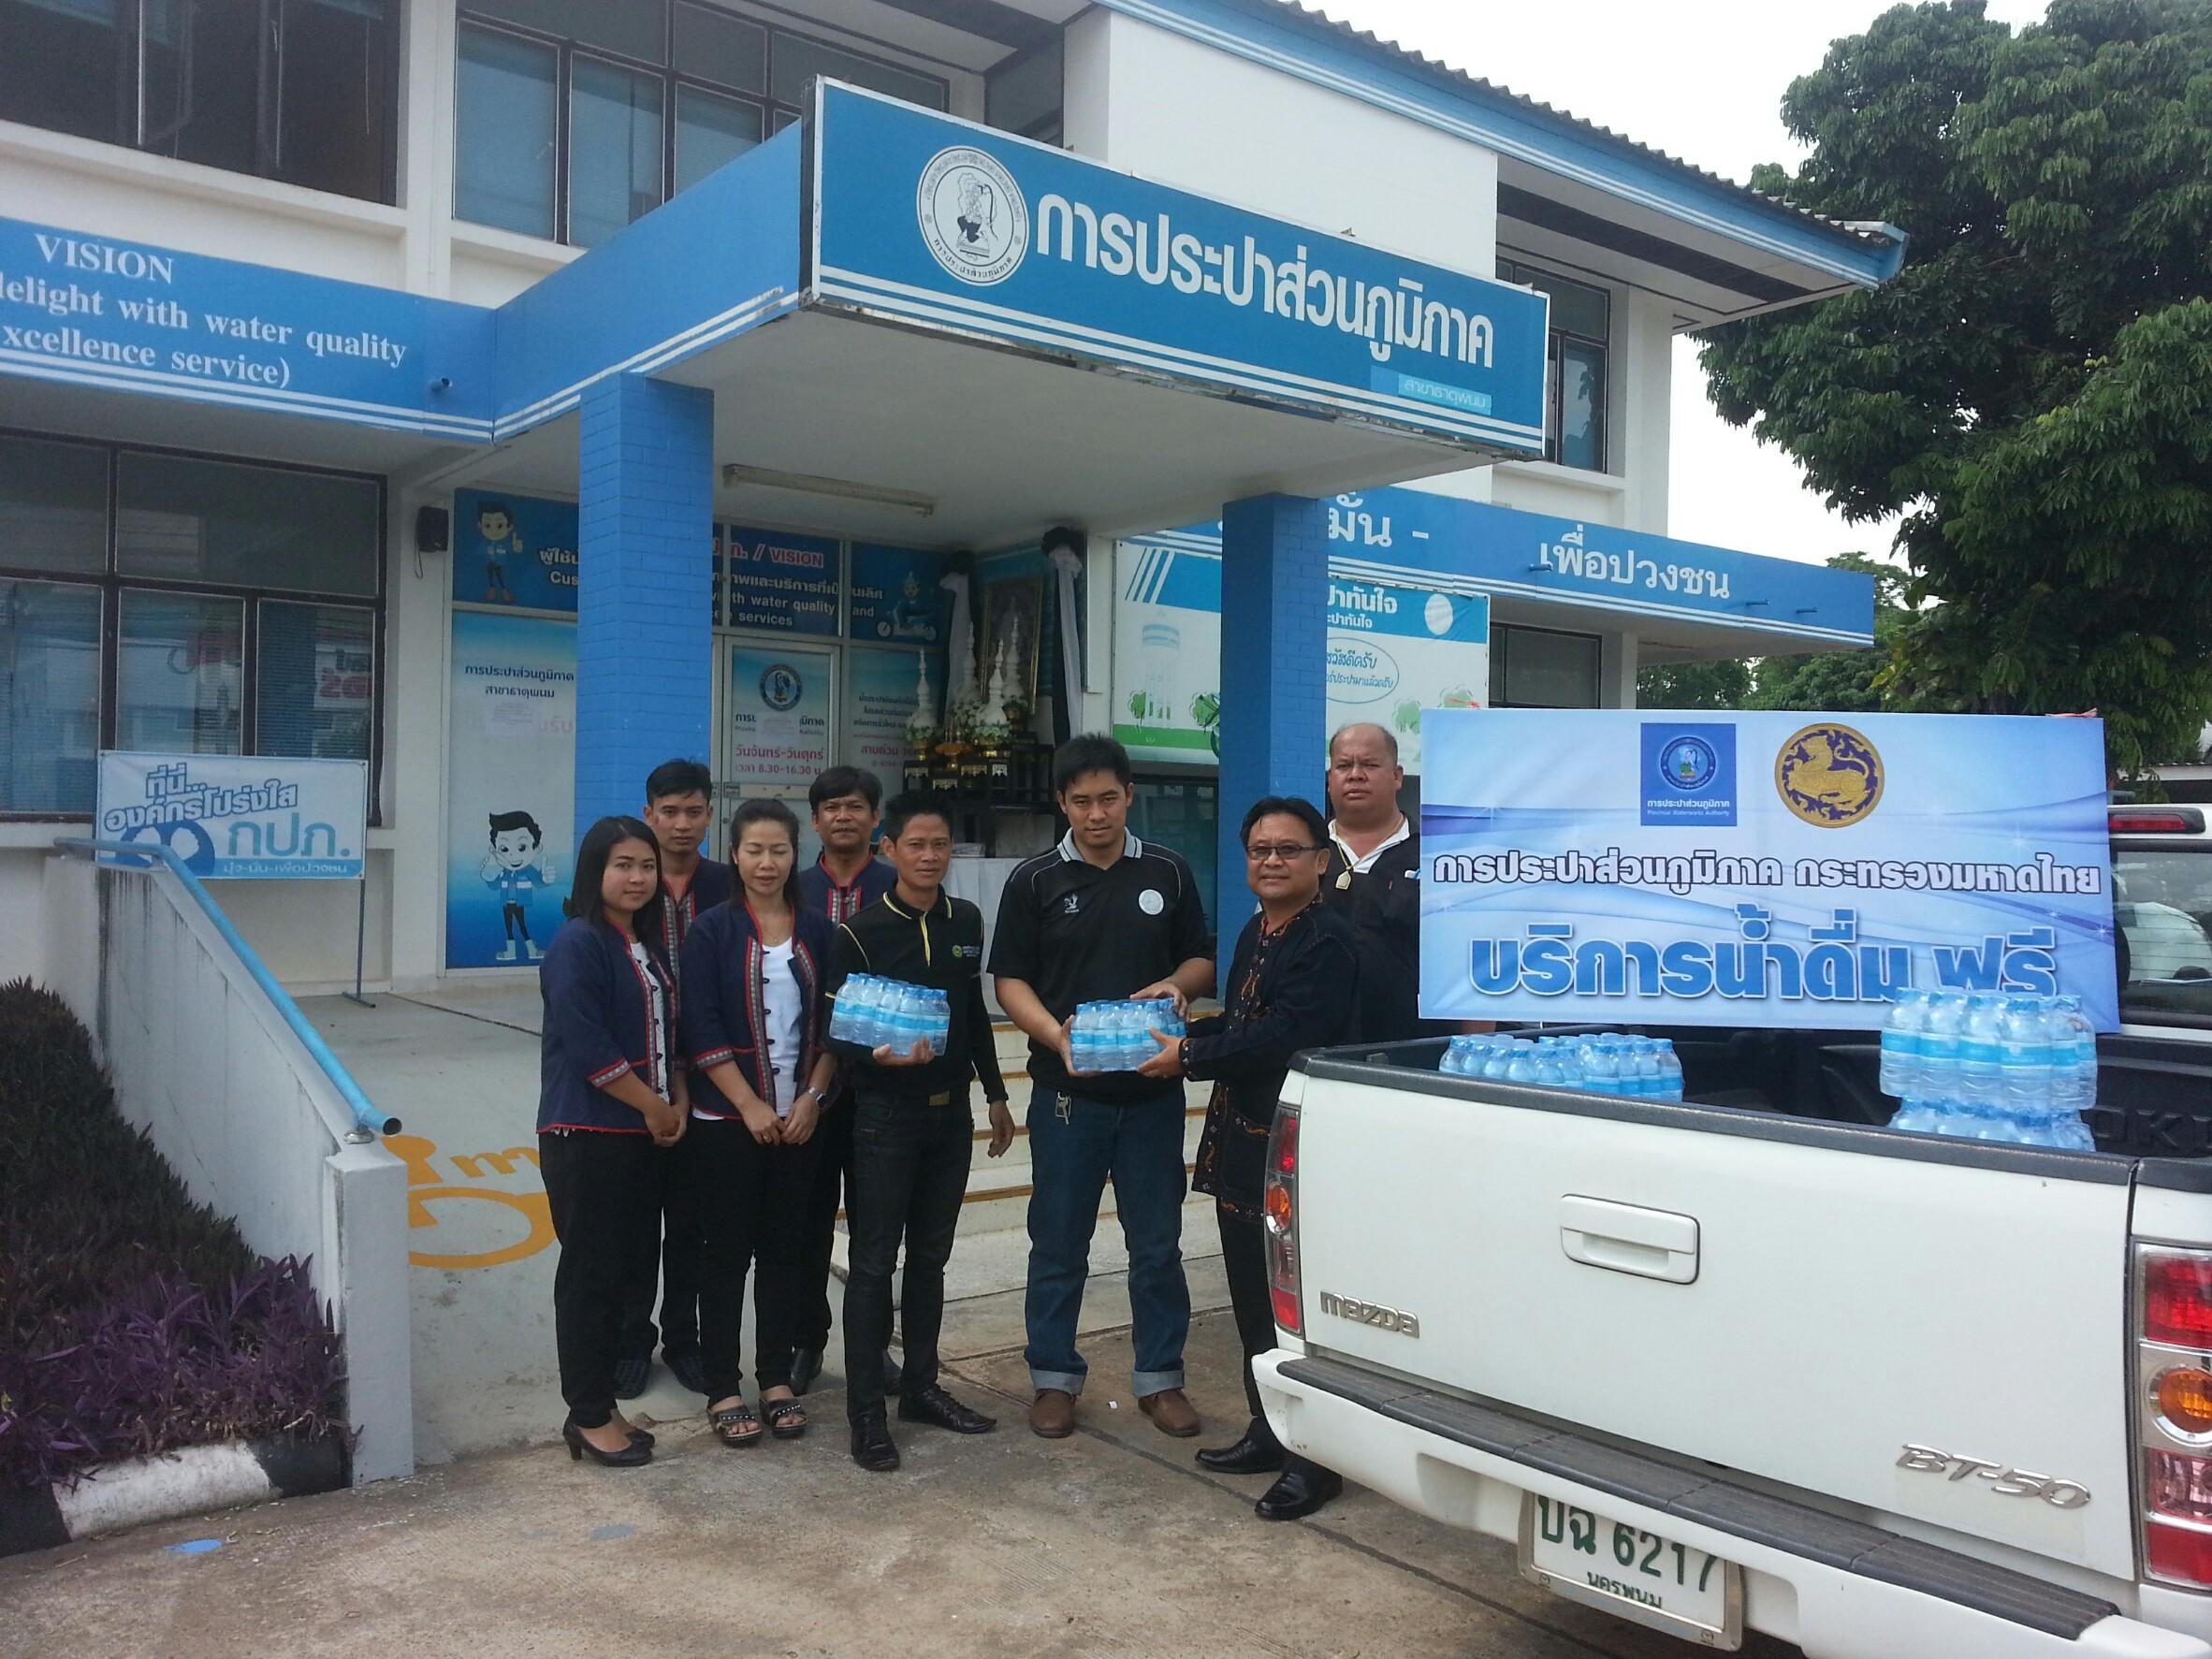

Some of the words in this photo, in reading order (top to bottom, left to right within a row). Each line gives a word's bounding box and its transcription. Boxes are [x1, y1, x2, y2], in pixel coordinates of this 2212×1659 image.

[35, 233, 174, 284] VISION
[1036, 193, 1493, 368] การประปาส่วนภูมิภาค
[118, 297, 189, 329] with
[205, 313, 293, 344] water
[306, 330, 407, 369] quality
[170, 350, 291, 388] service)
[768, 546, 824, 569] VISION
[1539, 524, 1730, 599] เพื่อปวงชน
[738, 613, 793, 627] services
[750, 594, 789, 608] water
[793, 599, 836, 616] quality
[852, 606, 875, 618] and
[1647, 799, 1730, 810] การประปาส่วนภูมิภาค
[1433, 848, 1782, 896] การประปาส่วนภูมิภาค
[1795, 852, 2102, 895] กระทรวงมหาดไทย
[1469, 903, 1911, 1002] บริการน้ำดื่ม
[1934, 925, 2058, 997] ฟรี
[1896, 1443, 2092, 1508] BT-50
[1612, 1521, 1720, 1593] 6217
[1587, 1571, 1663, 1609] นครพนม
